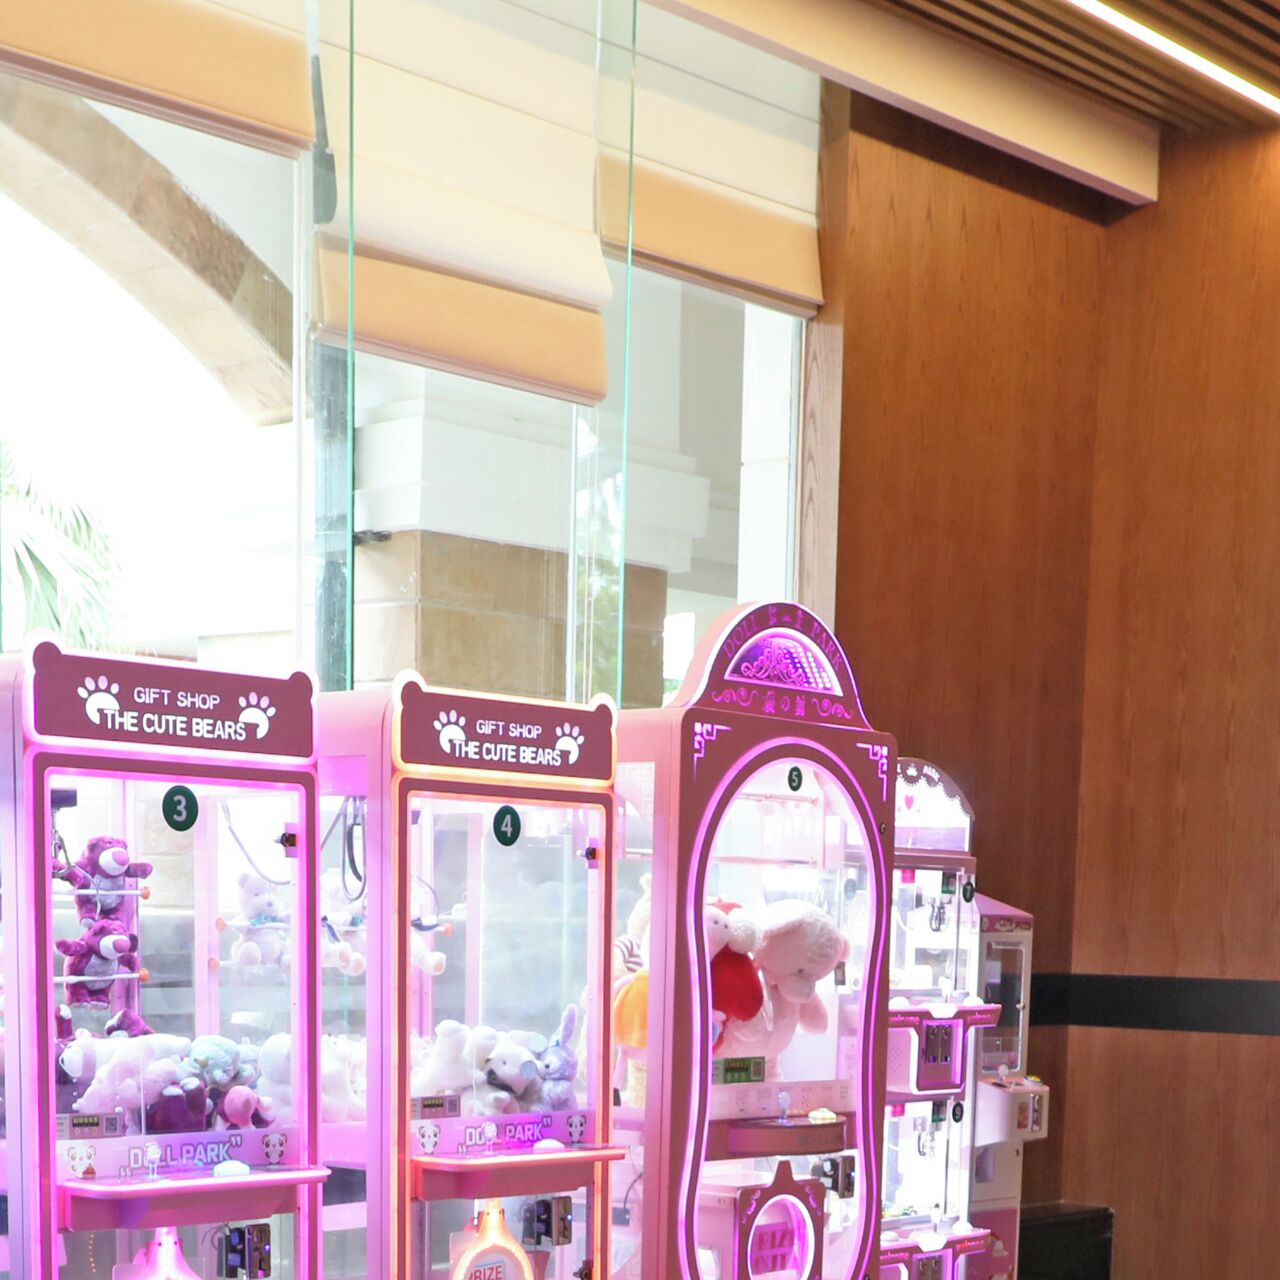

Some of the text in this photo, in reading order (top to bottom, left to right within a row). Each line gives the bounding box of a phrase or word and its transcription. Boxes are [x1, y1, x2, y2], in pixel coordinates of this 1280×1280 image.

[133, 686, 221, 710] GIFT SHOP
[104, 709, 247, 742] THE CUTE BEARS
[476, 719, 542, 739] GIFT SHOP
[453, 739, 562, 767] THE CUTE BEARS
[791, 771, 799, 787] 5
[172, 794, 188, 823] 3
[500, 812, 514, 839] 4
